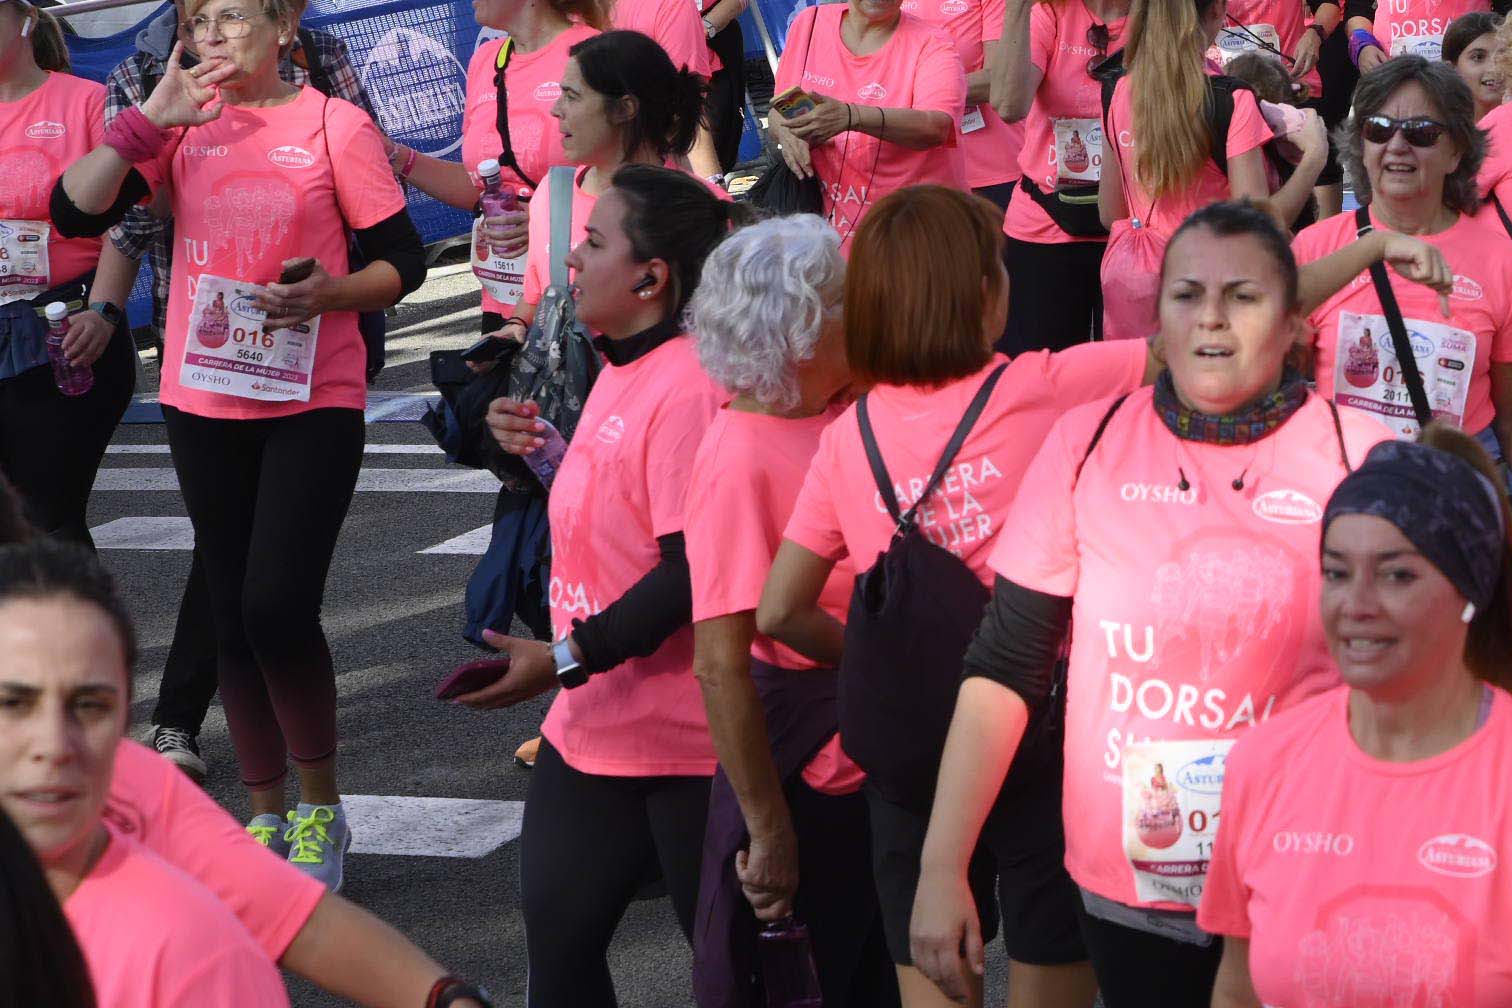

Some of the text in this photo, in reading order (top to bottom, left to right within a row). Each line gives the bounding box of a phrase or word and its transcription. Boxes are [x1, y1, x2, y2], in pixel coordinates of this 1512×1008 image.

[270, 153, 315, 166] ASTURIANA
[183, 237, 209, 267] TU
[493, 260, 515, 271] 15611
[232, 327, 275, 349] 016
[236, 348, 264, 362] 5640
[198, 357, 233, 370] CARRERA
[233, 363, 244, 371] DE
[245, 364, 255, 373] LA
[255, 366, 281, 378] MUJER
[191, 371, 302, 397] OYSHO Santander
[1347, 396, 1383, 412] CARRERA
[1383, 404, 1393, 415] DE
[1394, 407, 1406, 417] LA
[1120, 482, 1198, 506] OYSHO
[946, 492, 985, 522] LA
[1099, 619, 1155, 663] TU
[1273, 831, 1354, 856] OYSHO
